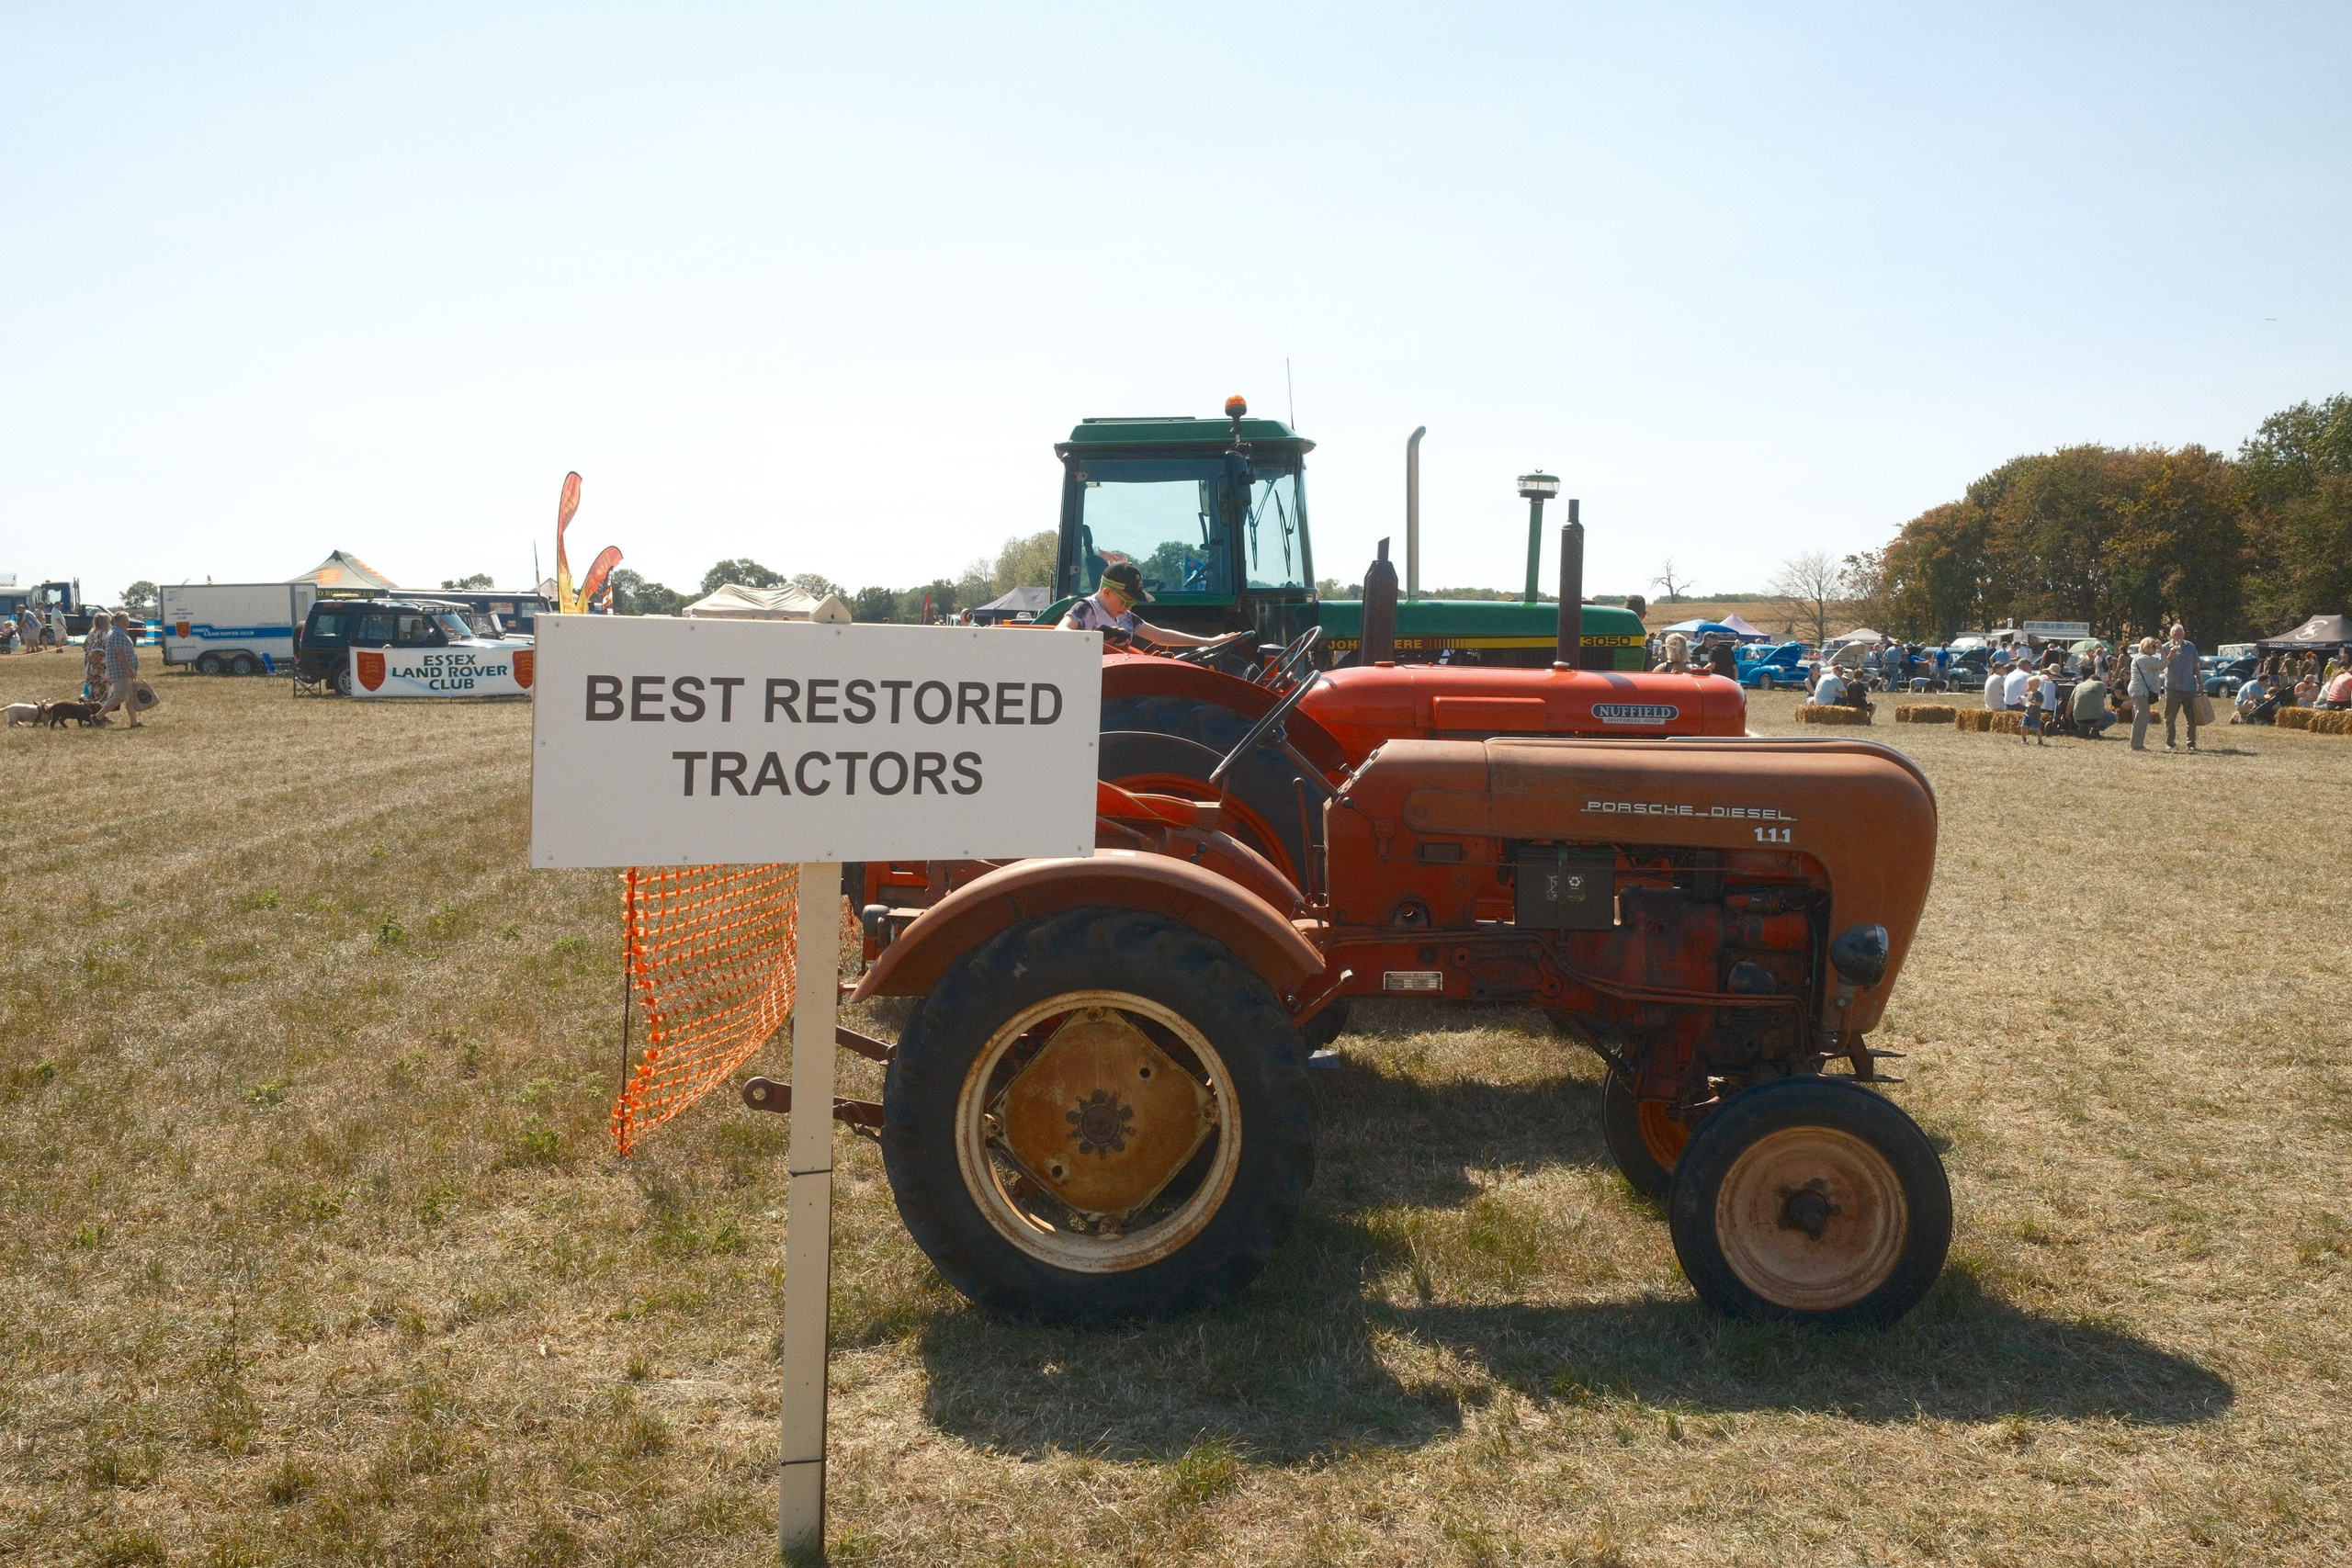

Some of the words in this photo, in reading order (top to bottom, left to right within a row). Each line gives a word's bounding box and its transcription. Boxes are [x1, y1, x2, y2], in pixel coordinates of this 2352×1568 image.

[1328, 639, 1361, 649] JOH
[1394, 639, 1422, 649] ERE
[1583, 637, 1631, 647] 3050
[423, 654, 476, 667] ESSEX
[391, 667, 443, 678] LAND
[447, 665, 507, 678] ROVER
[428, 678, 475, 690] CLUB
[585, 674, 745, 723] BEST
[764, 678, 1063, 726] RESTORED
[1599, 705, 1671, 717] NUFFIELD
[672, 750, 984, 797] TRACTORS
[1754, 827, 1791, 843] 111
